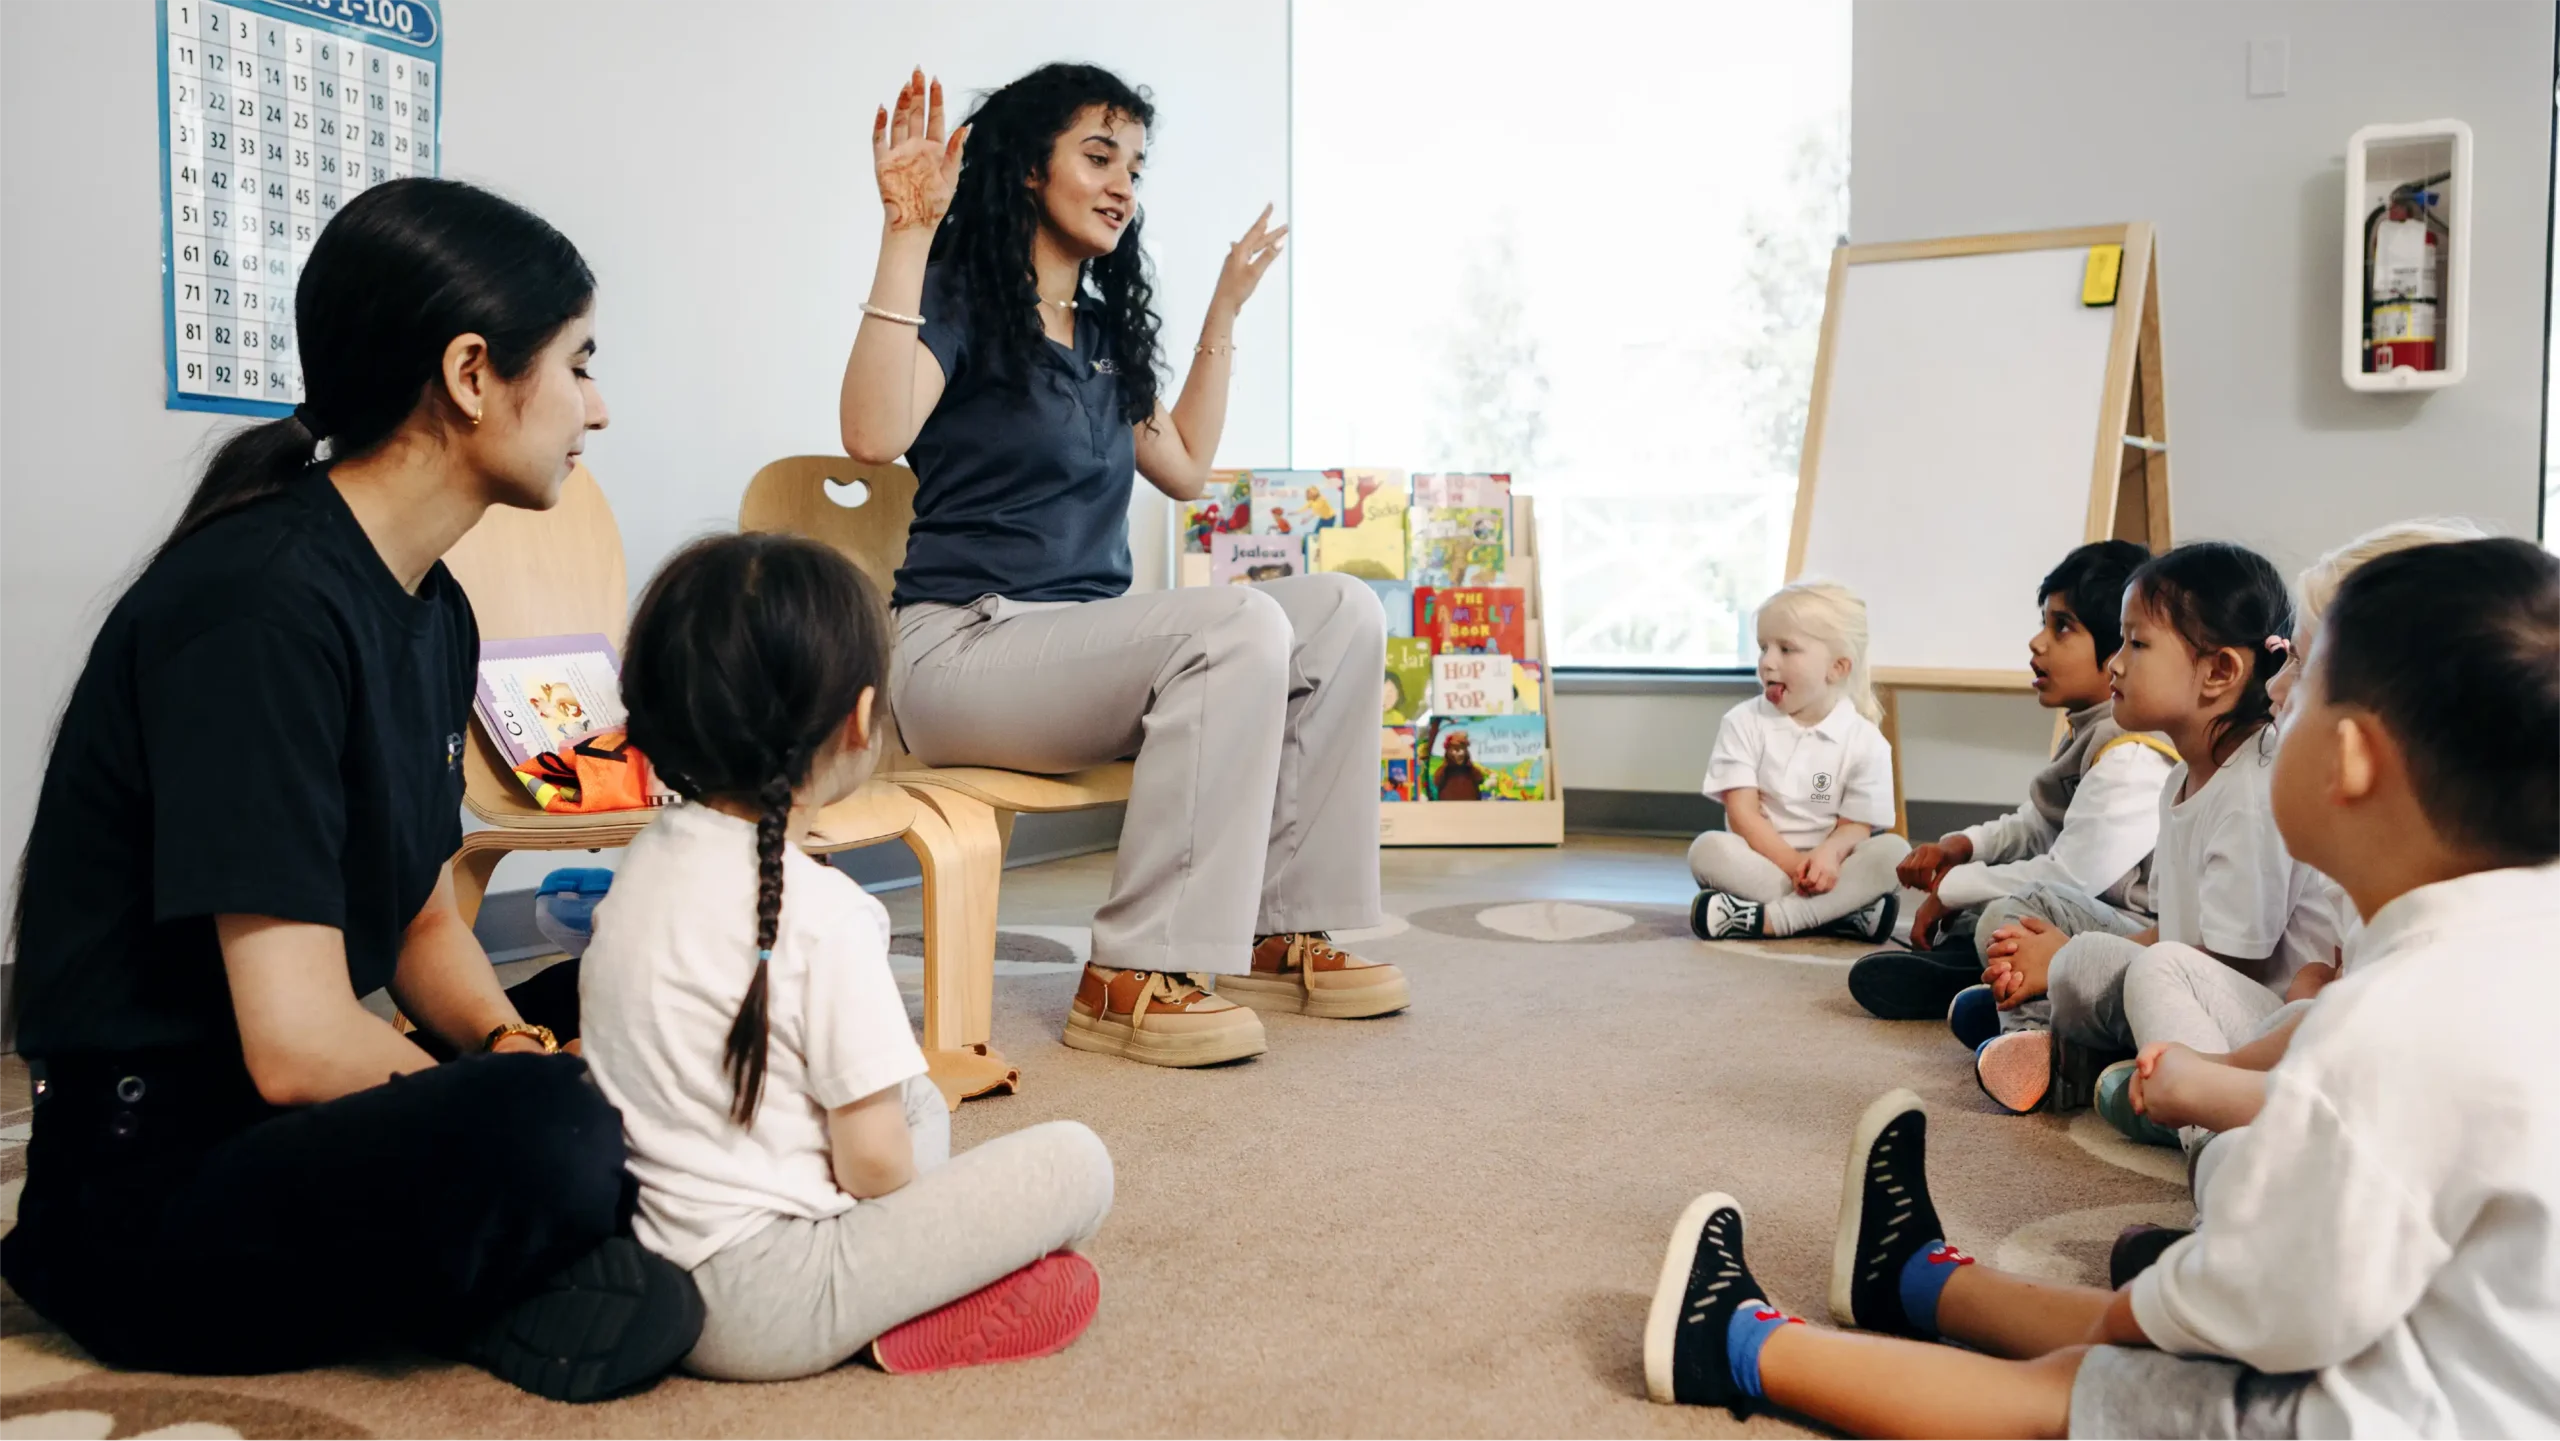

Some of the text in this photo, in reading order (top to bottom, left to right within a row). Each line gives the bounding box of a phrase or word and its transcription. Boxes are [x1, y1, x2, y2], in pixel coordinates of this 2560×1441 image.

[181, 8, 429, 87] 1 2 3 4 5 6 7 8 9 10
[180, 47, 429, 123] 11 12 13 14 15 16 17 18 19 20
[179, 86, 430, 158] 21 22 23 24 25 26 27 28 29 30
[180, 125, 195, 143] 31
[210, 132, 226, 150] 32
[240, 138, 254, 155] 33
[268, 144, 282, 161] 34
[295, 150, 309, 167] 35
[322, 155, 335, 173] 36
[347, 161, 360, 178] 37
[371, 166, 385, 183] 38
[181, 166, 336, 210] 41 42 43 44 45 46
[182, 206, 310, 241] 51 52 53 54 55
[184, 246, 200, 262] 61
[214, 250, 229, 267] 62
[242, 256, 258, 271] 63
[269, 260, 285, 276] 64
[185, 284, 285, 314] 71 72 73 74
[186, 324, 285, 352] 81 82 83 84
[187, 363, 202, 380] 91
[216, 366, 230, 383] 92
[244, 370, 258, 386] 93
[271, 373, 285, 389] 94
[1232, 544, 1286, 562] Jealous
[1424, 596, 1514, 625] FAMILY
[1454, 592, 1484, 604] THE
[1444, 660, 1485, 680] HOP
[1445, 690, 1485, 710] POP
